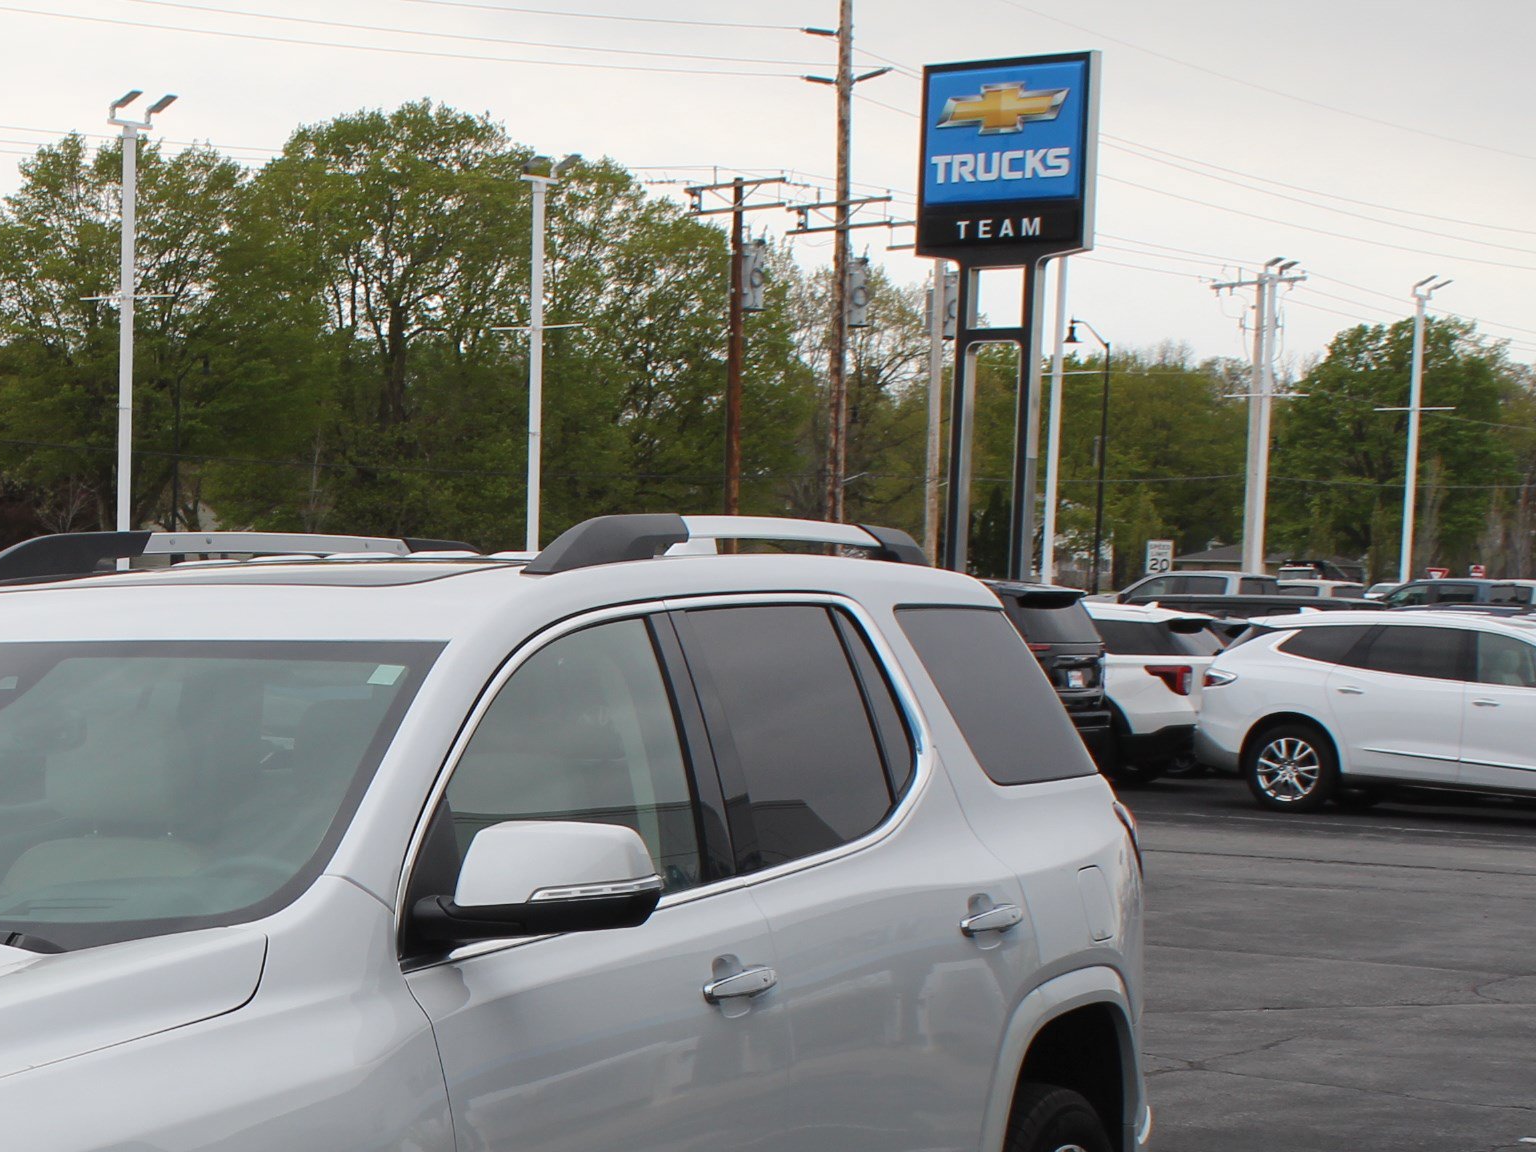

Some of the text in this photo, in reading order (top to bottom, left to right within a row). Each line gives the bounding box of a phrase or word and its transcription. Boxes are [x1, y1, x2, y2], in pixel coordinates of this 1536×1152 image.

[931, 147, 1070, 184] TRUCKS
[957, 217, 1041, 239] TEAM
[1149, 558, 1169, 571] 20
